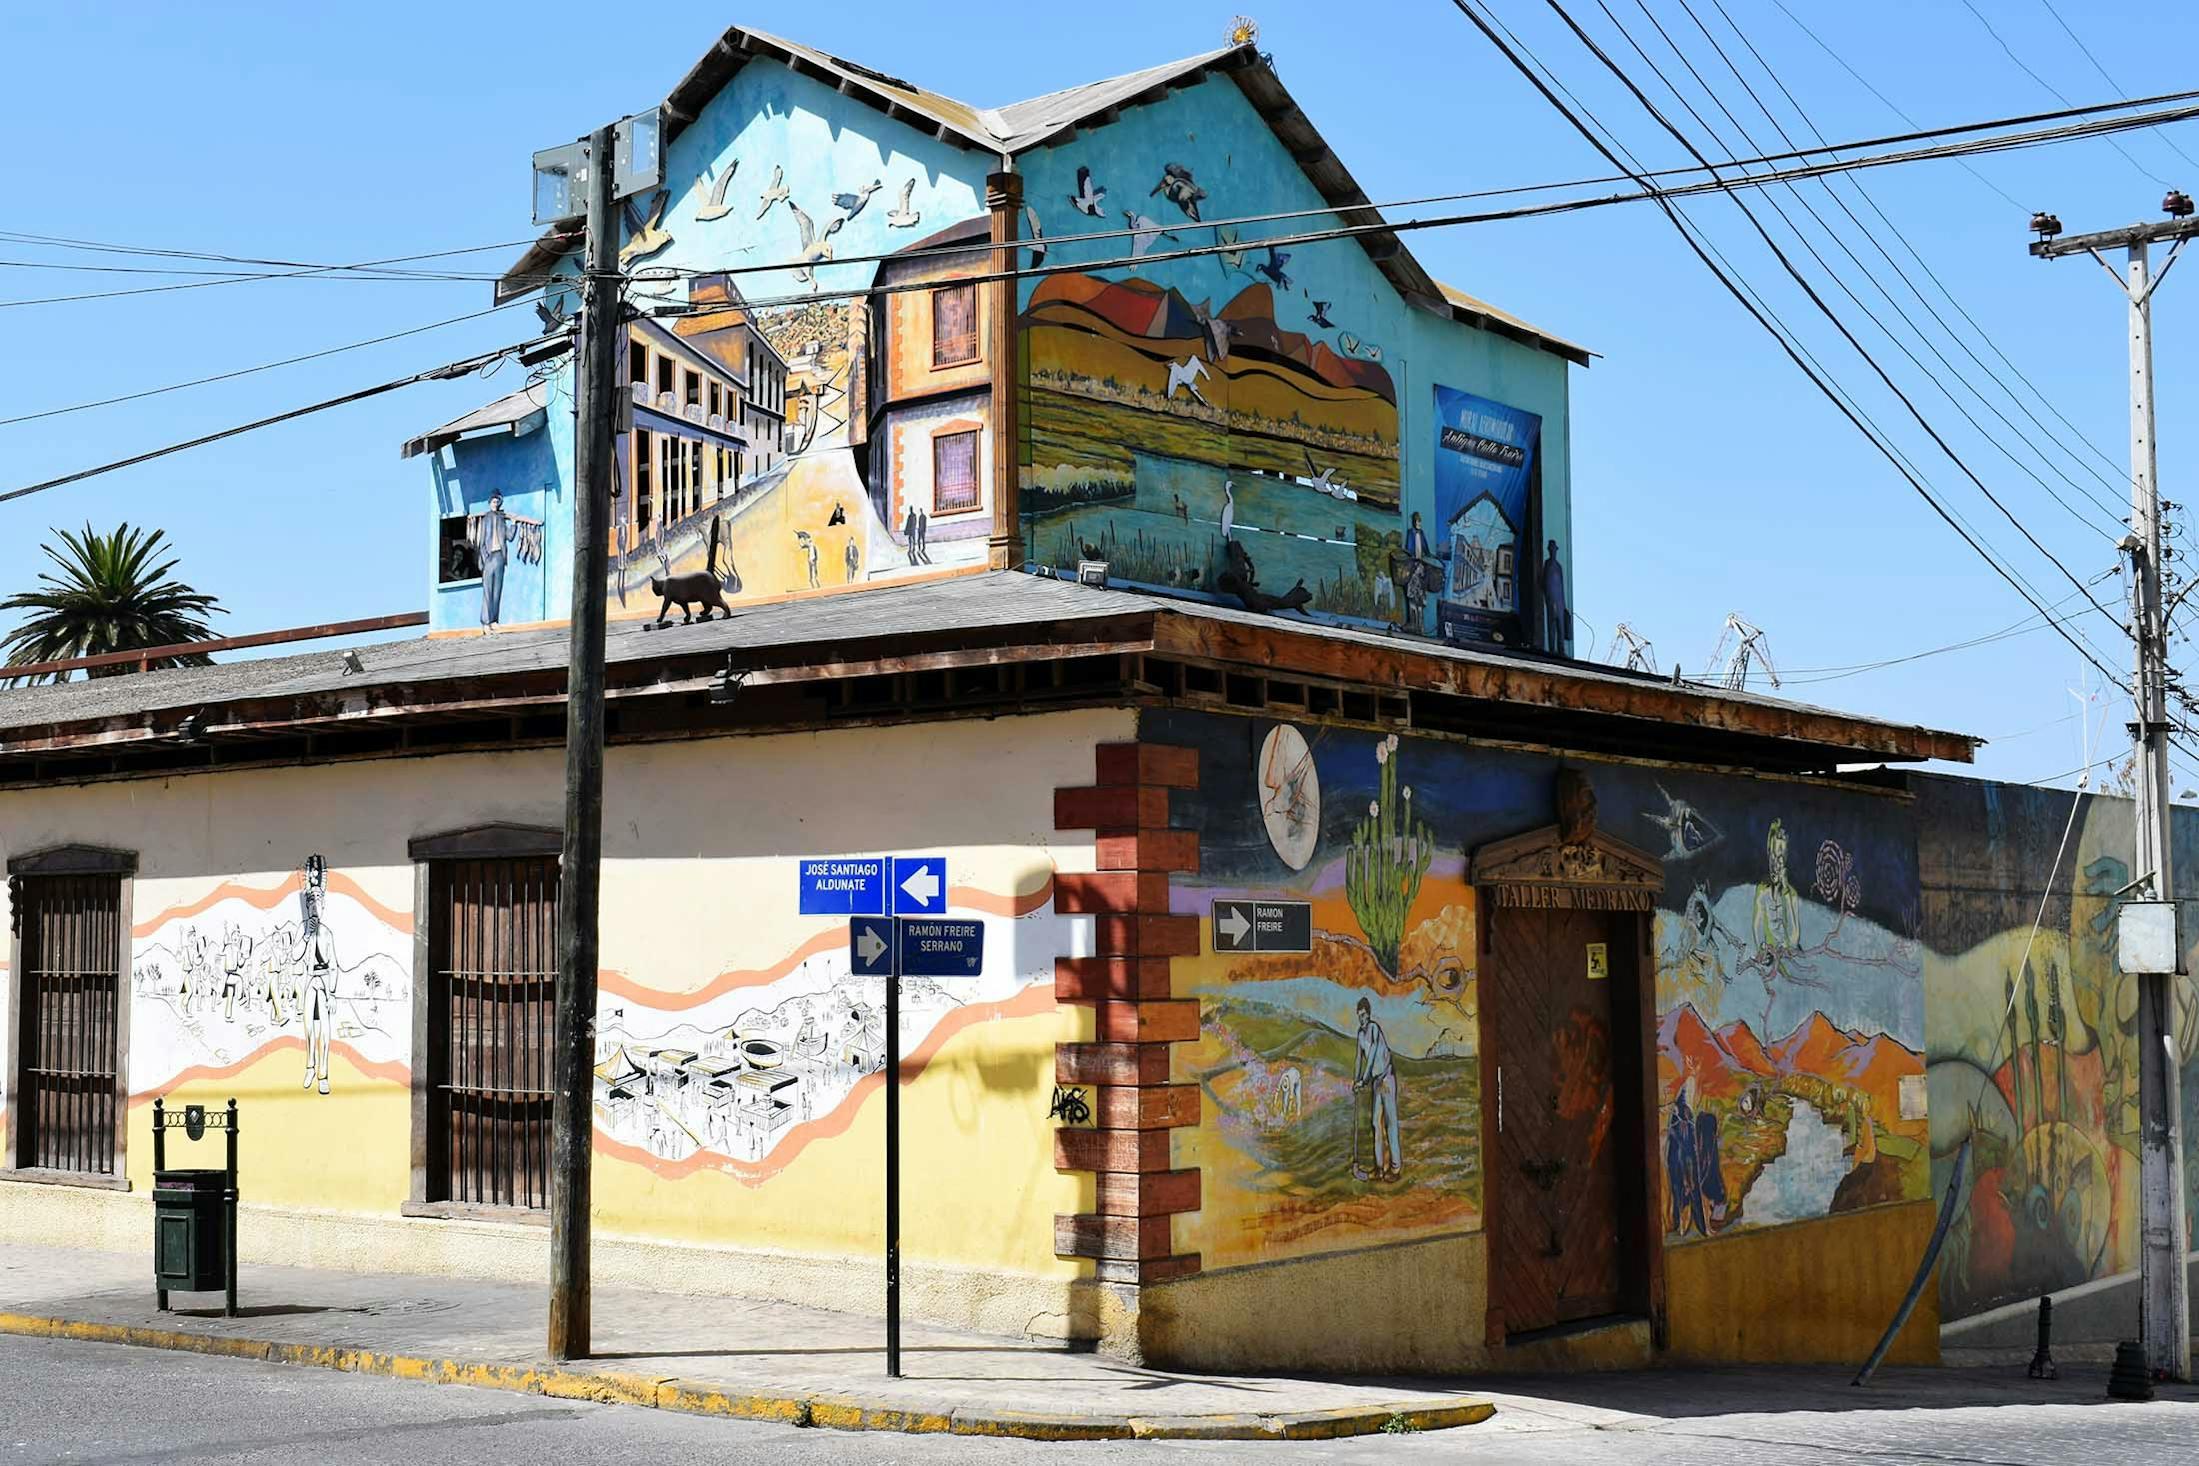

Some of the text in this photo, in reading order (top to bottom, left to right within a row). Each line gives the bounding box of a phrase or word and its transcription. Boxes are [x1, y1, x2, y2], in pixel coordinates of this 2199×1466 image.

[805, 861, 878, 876] JOSÉ SANTIAGO
[815, 878, 866, 891] ALDUNATE
[1498, 884, 1650, 911] TALLER MEDRANO
[1256, 907, 1283, 918] RAMON
[908, 922, 976, 937] RAMÓN FREIRE
[1257, 921, 1283, 932] FREIRE
[920, 940, 963, 952] SERRANO
